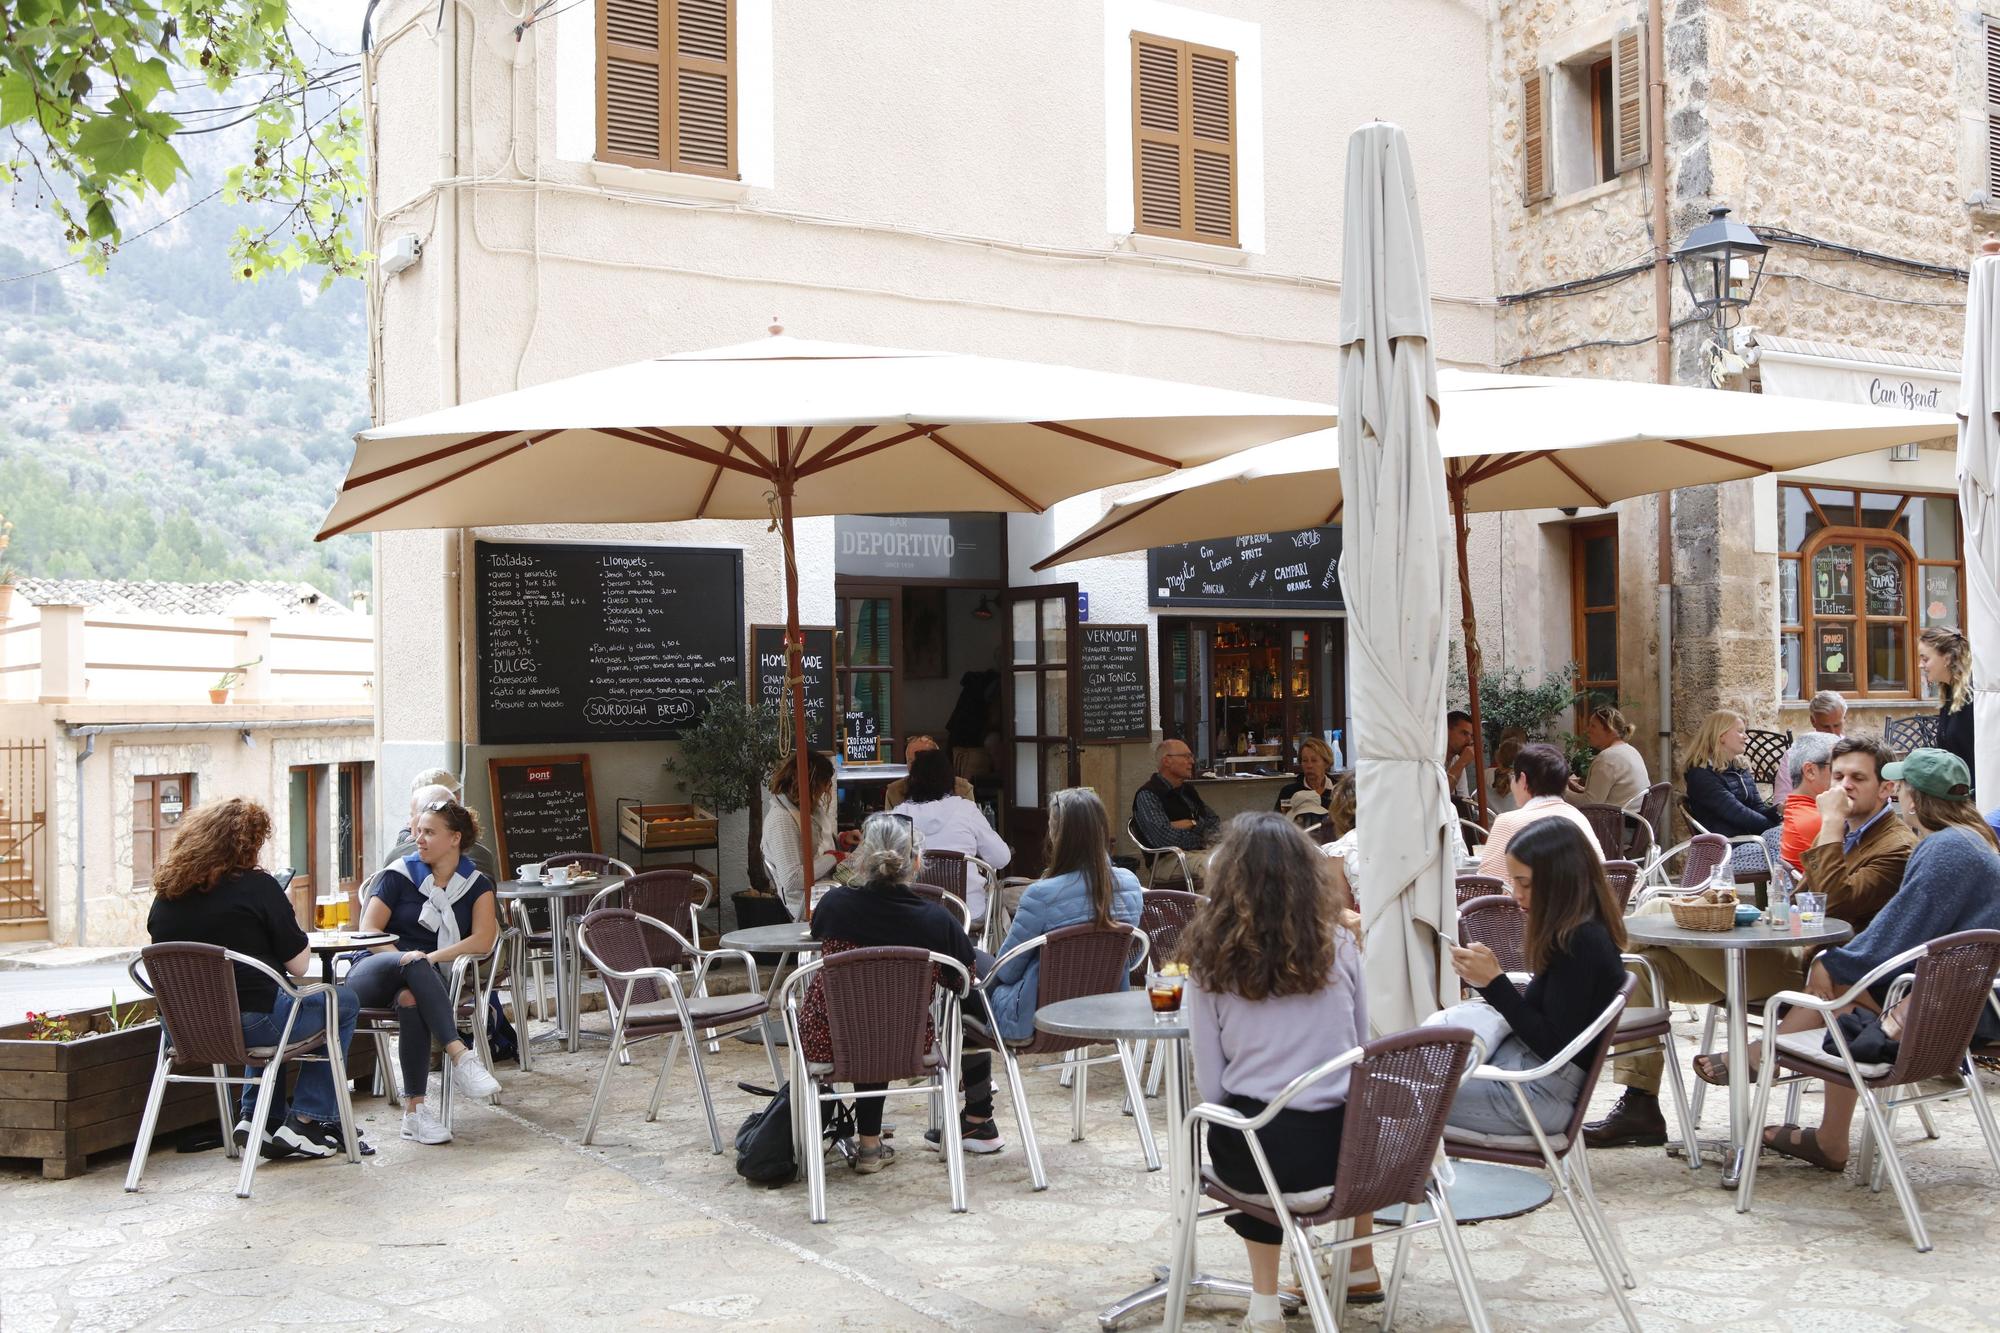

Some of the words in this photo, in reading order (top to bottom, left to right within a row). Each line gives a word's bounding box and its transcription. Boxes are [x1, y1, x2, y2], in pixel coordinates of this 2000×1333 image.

[1870, 378, 1897, 405] Can
[1900, 381, 1942, 411] Benet
[841, 531, 955, 558] DEPORTIVO
[1201, 546, 1213, 558] Gin
[603, 556, 647, 569] Llonguets
[1275, 562, 1308, 580] CAMPARI
[1287, 580, 1312, 591] ORANGE
[1871, 574, 1895, 588] TAPAS
[1086, 630, 1137, 642] VERMOUTH
[494, 639, 519, 647] Huevos
[493, 676, 538, 684] Cheesecake
[1089, 672, 1105, 686] GIN
[590, 703, 647, 716] SOURDOUGH
[657, 703, 688, 716] BREAD
[847, 736, 877, 745] CROISSANT
[529, 771, 550, 780] pont
